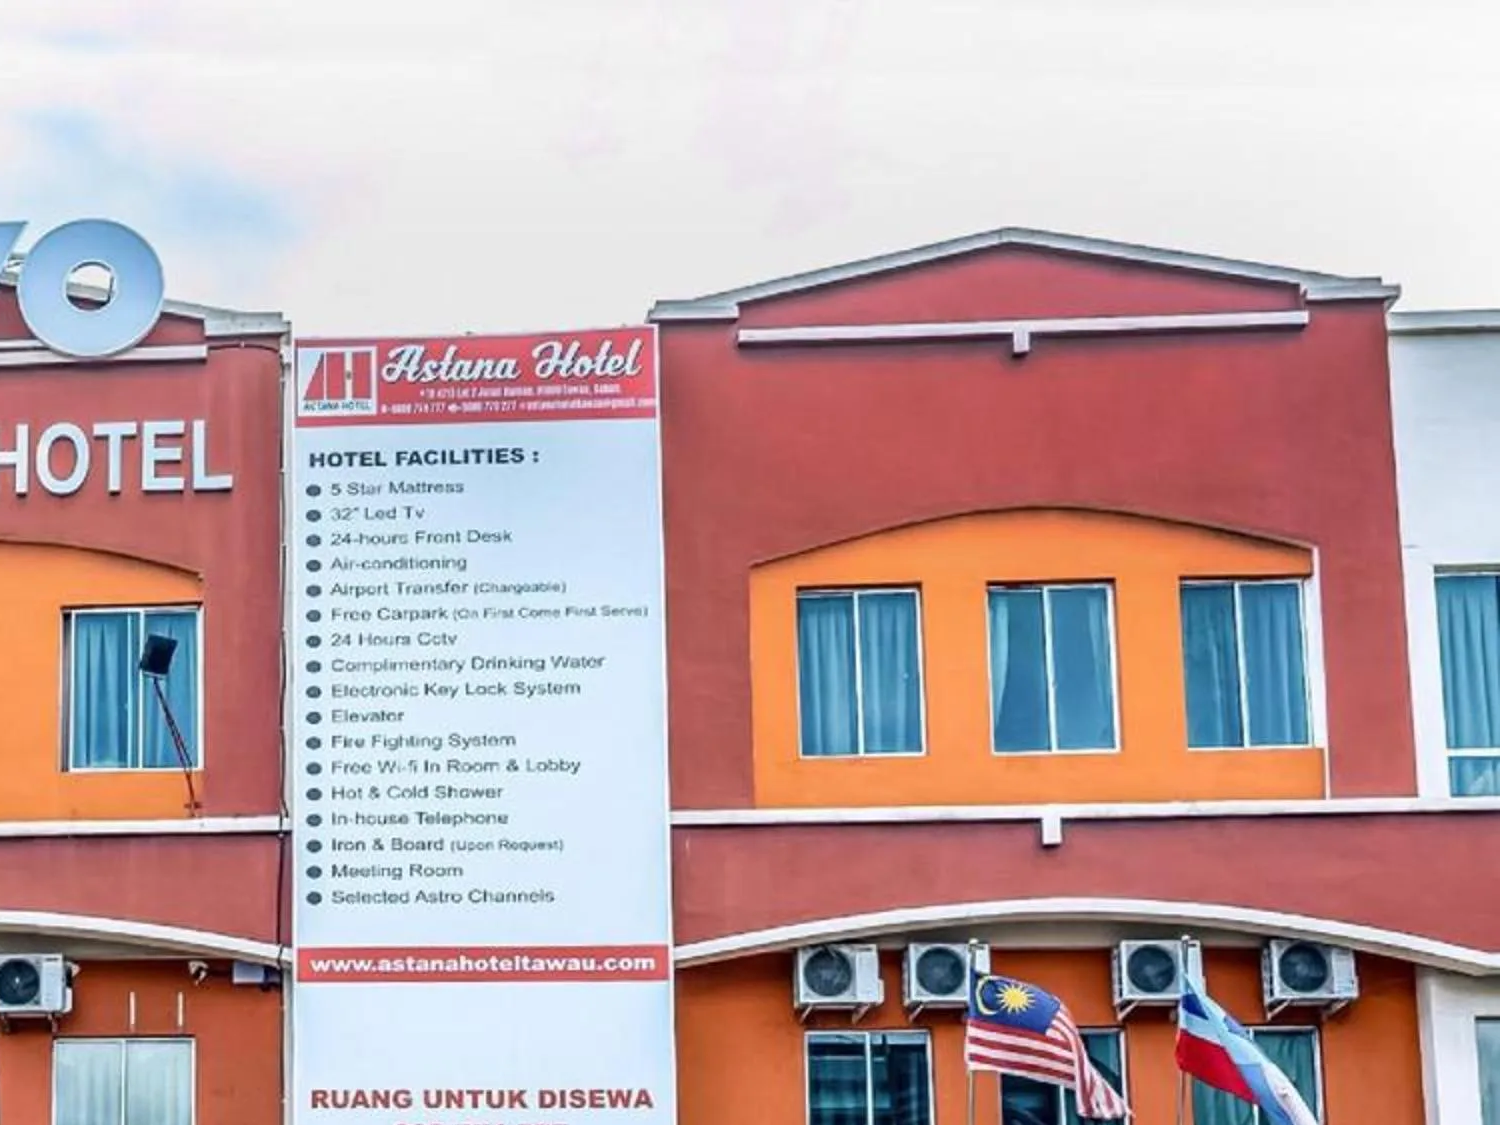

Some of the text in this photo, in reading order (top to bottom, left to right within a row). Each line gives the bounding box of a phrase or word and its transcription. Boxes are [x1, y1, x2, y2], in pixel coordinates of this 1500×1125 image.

[381, 338, 644, 382] Astana Hotel
[309, 451, 387, 468] HOTEL
[395, 448, 525, 466] FACILITIES
[331, 481, 465, 496] 5 Star Mattress
[365, 506, 397, 520] Led
[403, 507, 425, 520] Tv
[331, 529, 513, 546] 24-hours Front Desk
[331, 556, 467, 572] Air-conditioning
[331, 583, 390, 598] Airport
[397, 581, 469, 596] Transfer
[331, 607, 372, 621] Free
[377, 606, 449, 622] Carpark
[483, 607, 515, 619] First
[518, 606, 561, 618] Come
[566, 606, 598, 618] First
[331, 632, 458, 647] 24 Hours Cctv
[331, 655, 606, 674] Complimentary Drinking Water
[331, 681, 581, 699] Electronic Key Lock System
[331, 709, 405, 724] Elevator
[331, 733, 516, 751] Fire Fighting System
[331, 761, 372, 775] Free
[424, 760, 441, 773] In
[447, 760, 500, 774] Room
[506, 760, 519, 773] &
[526, 759, 581, 776] Lobby
[331, 785, 503, 800] Hot & Cold Shower
[331, 812, 509, 829] In-house Telephone
[331, 838, 366, 852] Iron
[372, 838, 385, 852] &
[391, 837, 445, 852] Board
[331, 864, 463, 881] Meeting Room
[331, 888, 555, 904] Selected Astro Channels
[310, 1089, 654, 1109] RUANG UNTUK DISEWA
